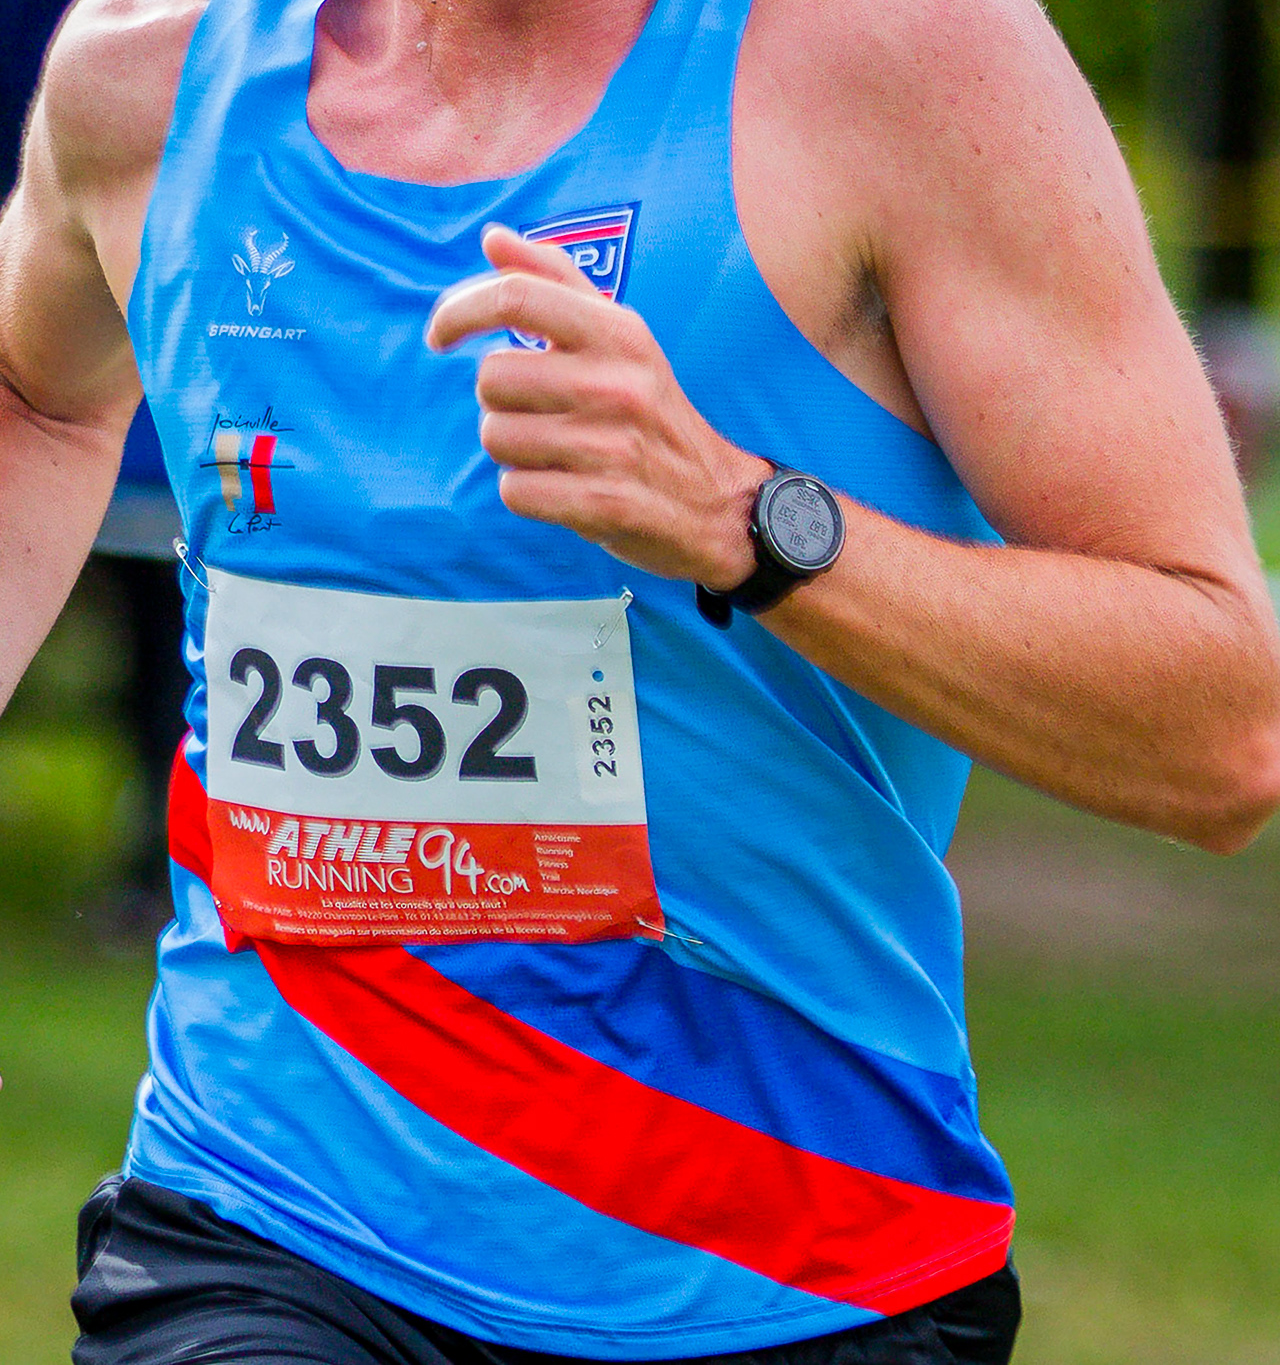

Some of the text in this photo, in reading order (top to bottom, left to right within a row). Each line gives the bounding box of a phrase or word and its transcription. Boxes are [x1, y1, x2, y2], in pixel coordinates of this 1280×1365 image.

[565, 241, 618, 277] PJ
[208, 324, 307, 340] SPRINGART
[206, 405, 296, 456] Joinville
[228, 646, 539, 783] 2352
[587, 695, 618, 778] 2352
[267, 819, 418, 864] ATHLE
[268, 859, 415, 894] RUNNING
[369, 900, 380, 909] et
[381, 900, 394, 909] les
